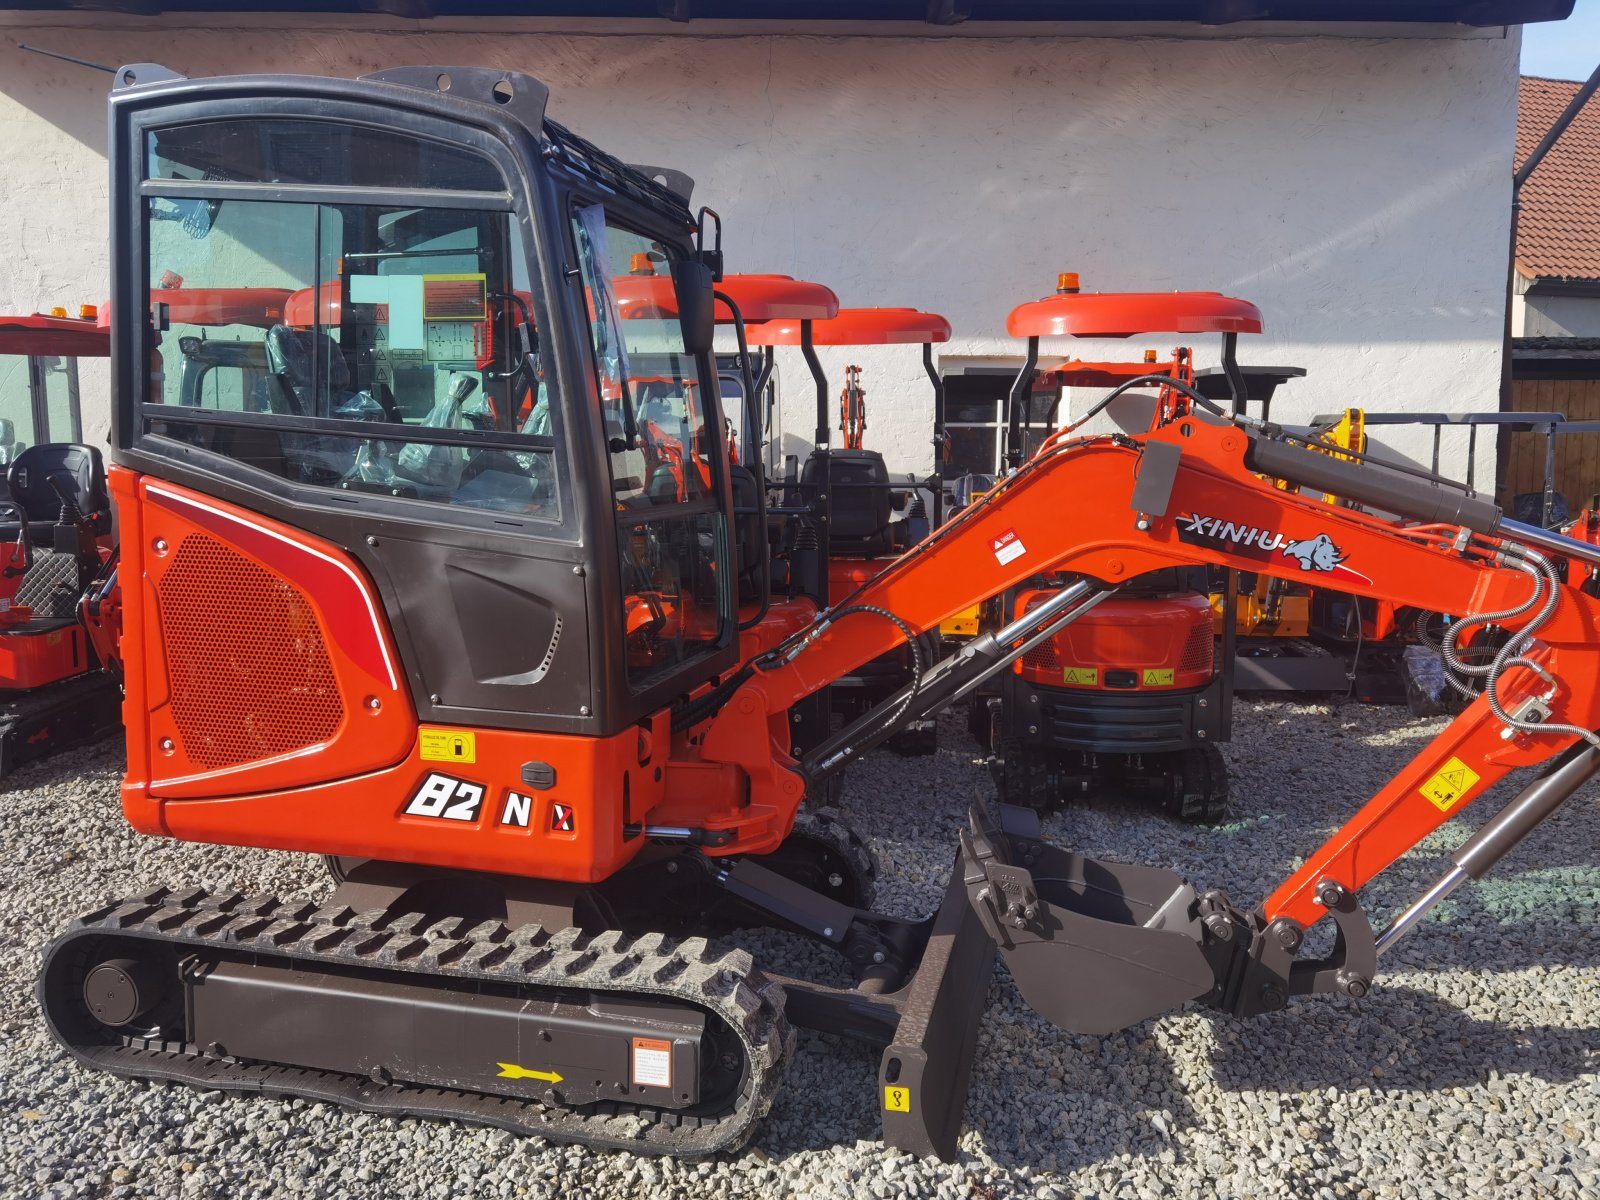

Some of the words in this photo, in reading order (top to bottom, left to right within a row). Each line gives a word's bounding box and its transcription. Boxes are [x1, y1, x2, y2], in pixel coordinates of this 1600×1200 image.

[1184, 512, 1285, 551] XINIU
[405, 773, 483, 821] 82
[501, 791, 531, 827] N
